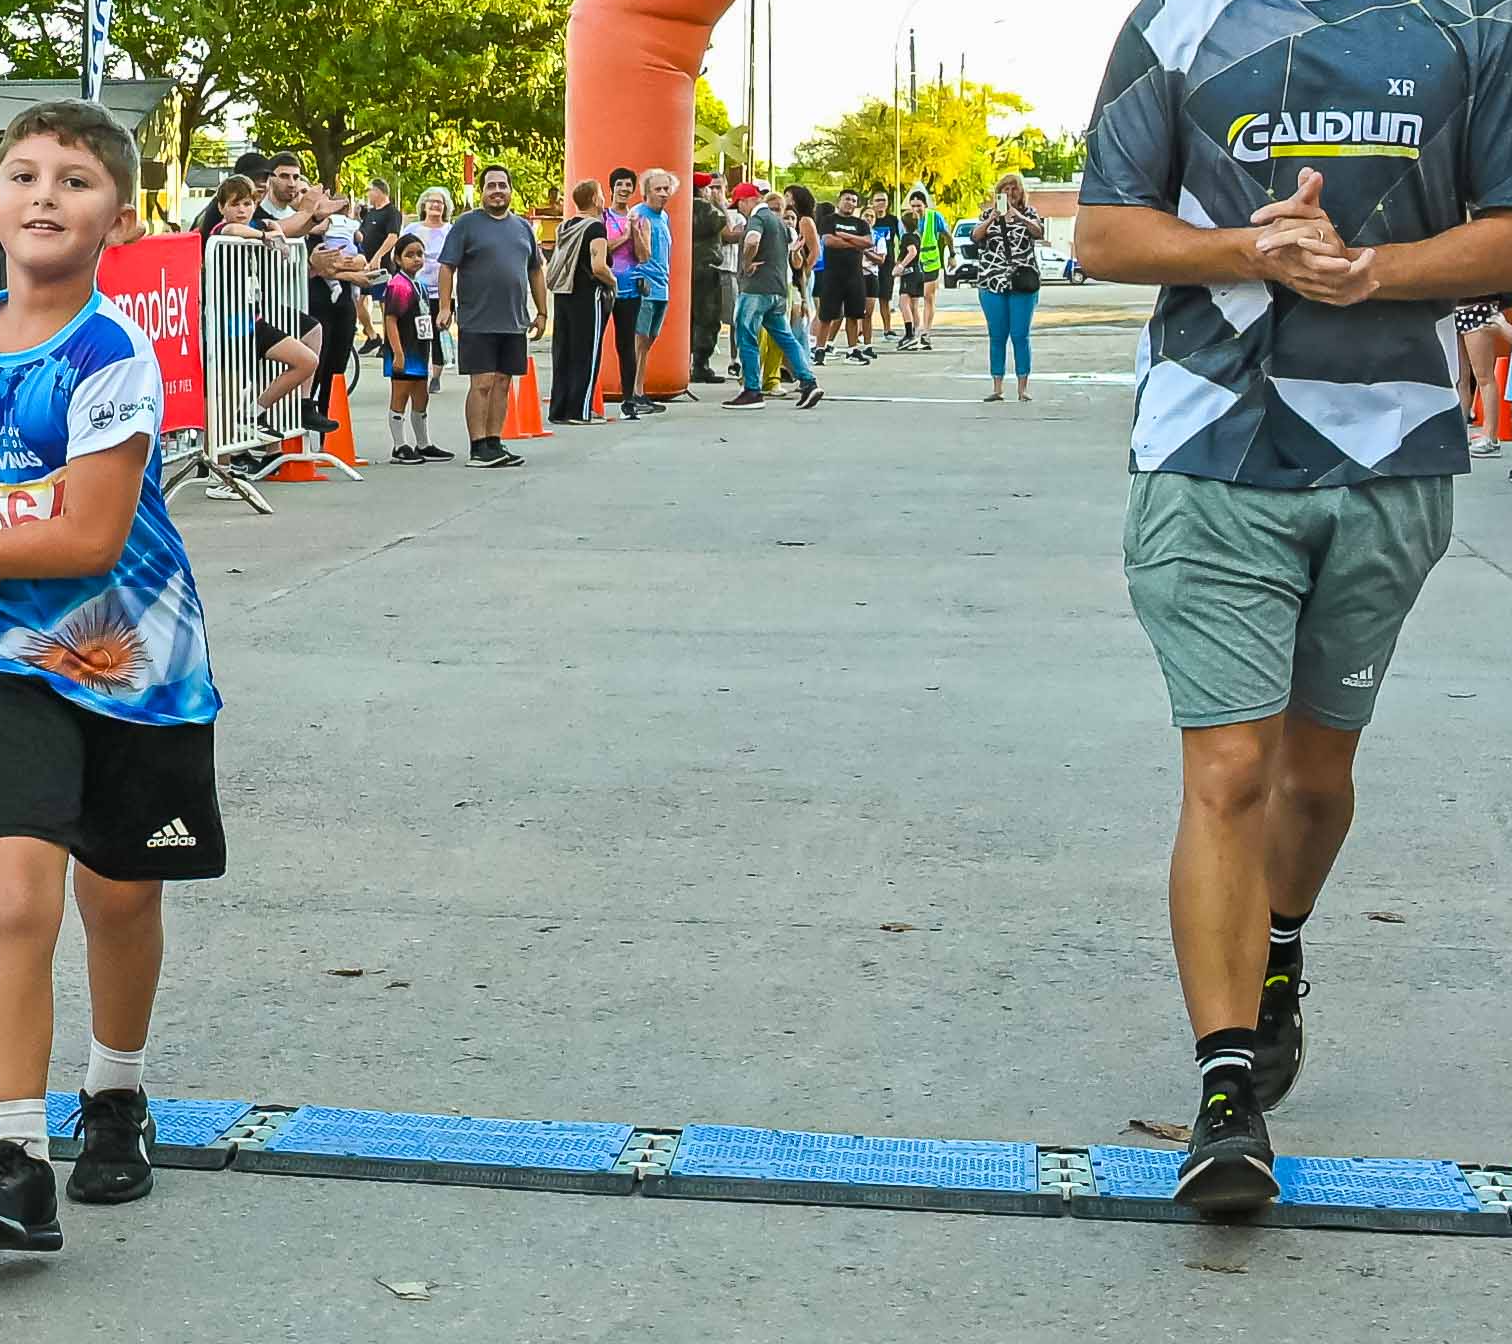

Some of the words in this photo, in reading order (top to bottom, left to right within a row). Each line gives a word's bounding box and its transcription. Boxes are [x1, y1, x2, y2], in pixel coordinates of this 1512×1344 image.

[1387, 78, 1415, 97] XR
[1232, 111, 1424, 163] GAUDIUM
[146, 834, 197, 848] adidas
